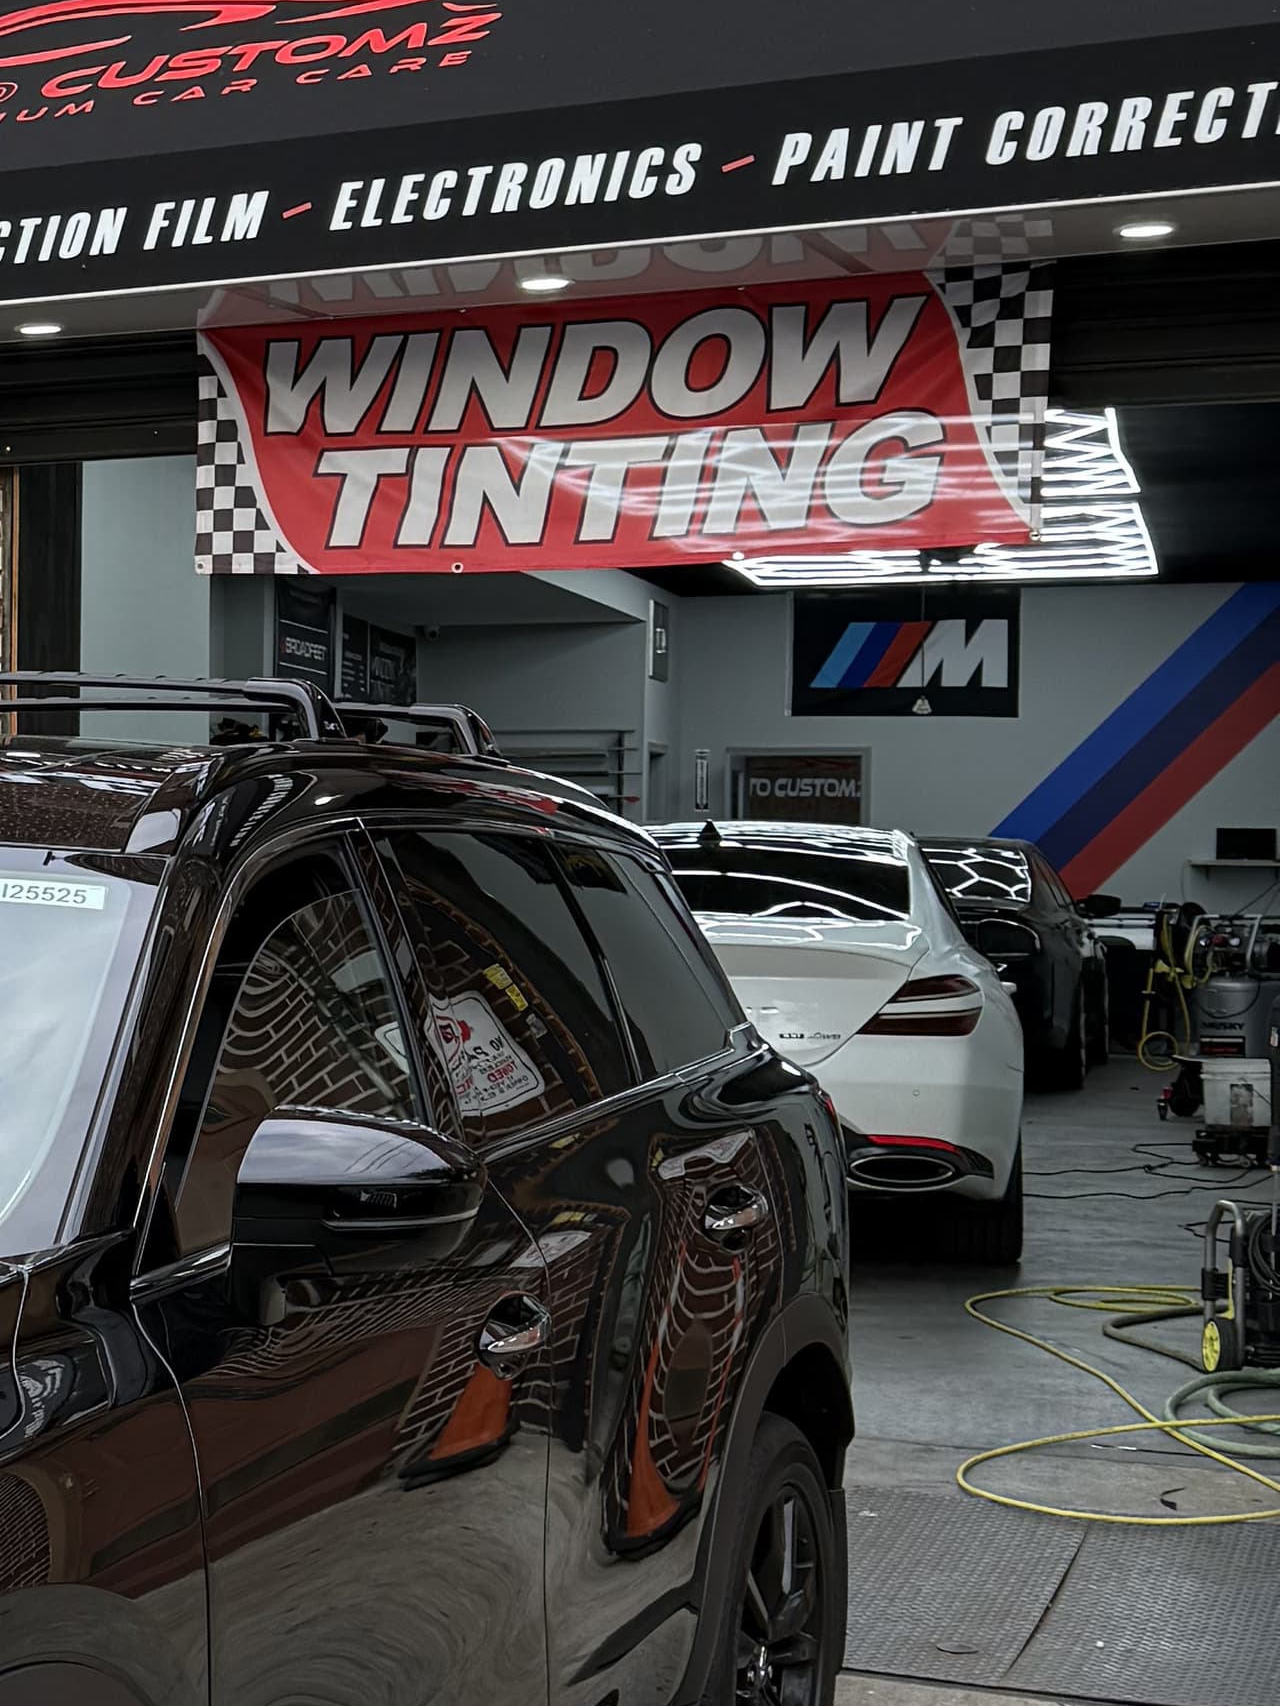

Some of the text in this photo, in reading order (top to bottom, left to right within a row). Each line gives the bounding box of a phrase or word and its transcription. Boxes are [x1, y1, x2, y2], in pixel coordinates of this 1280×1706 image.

[38, 5, 504, 99] CUSTOMZ
[131, 79, 258, 107] CAR
[295, 51, 472, 86] CARE
[142, 191, 270, 250] FILM
[328, 142, 702, 231] ELECTRONICS
[772, 116, 963, 185] PAINT
[984, 81, 1280, 166] CORRECT
[262, 295, 929, 437] WINDOW
[314, 408, 945, 551] TINTING
